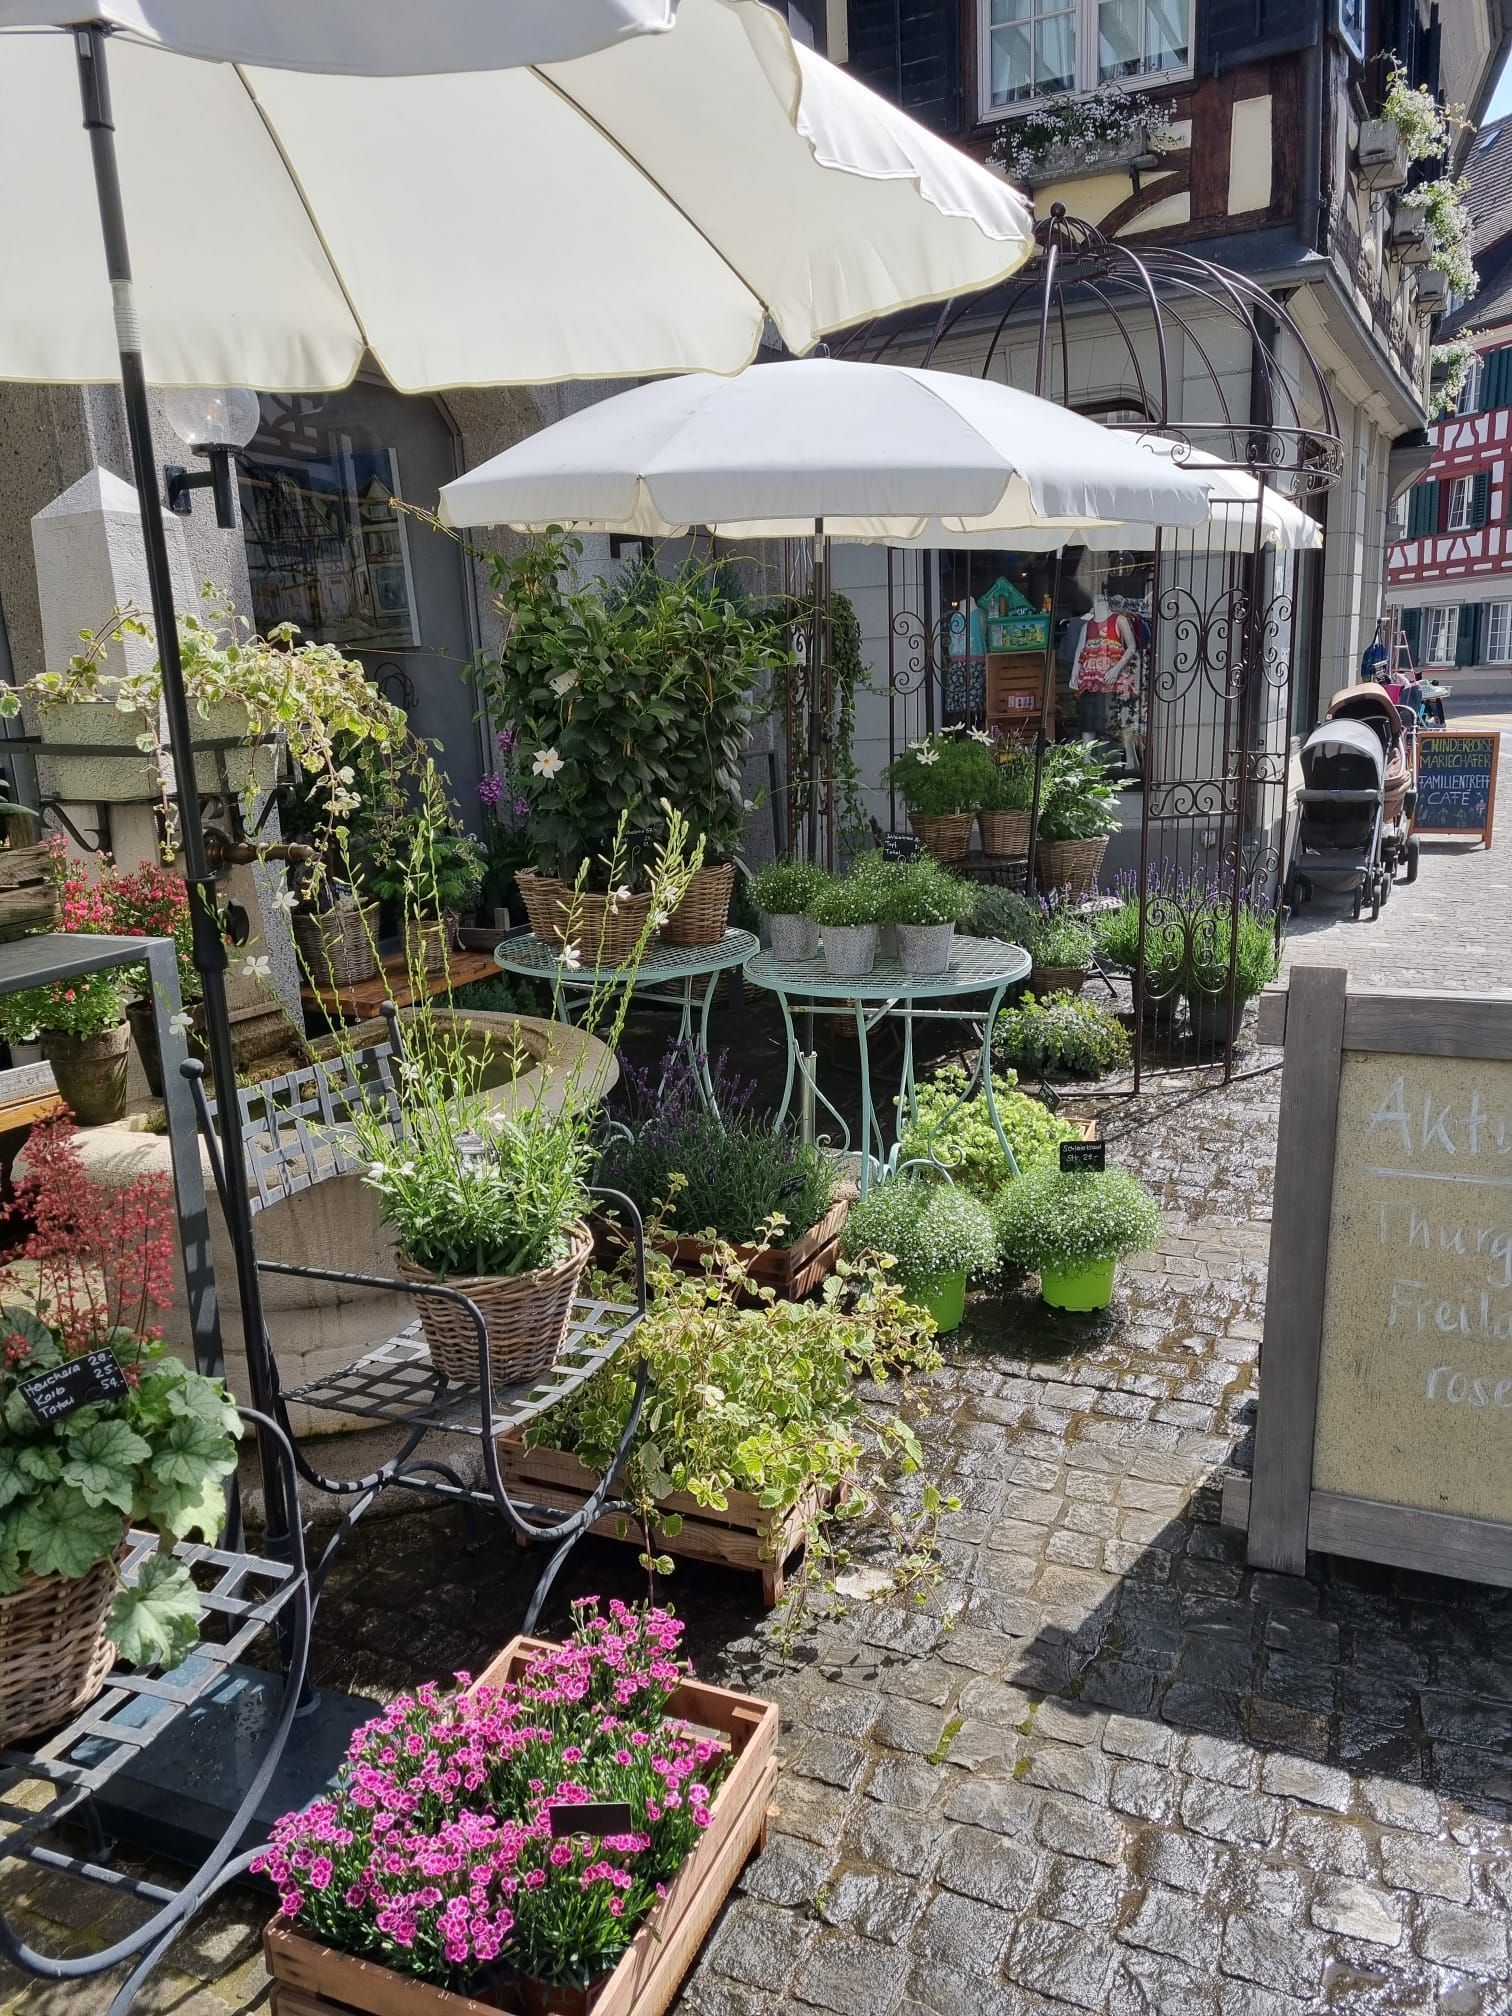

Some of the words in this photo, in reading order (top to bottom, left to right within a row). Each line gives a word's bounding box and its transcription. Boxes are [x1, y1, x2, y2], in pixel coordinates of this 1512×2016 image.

[1418, 774, 1491, 790] FAMILIENTREFF
[1427, 788, 1471, 806] CAFÉ
[23, 1364, 81, 1398] Heuchera
[33, 1386, 66, 1407] Korb
[38, 1396, 75, 1420] Total
